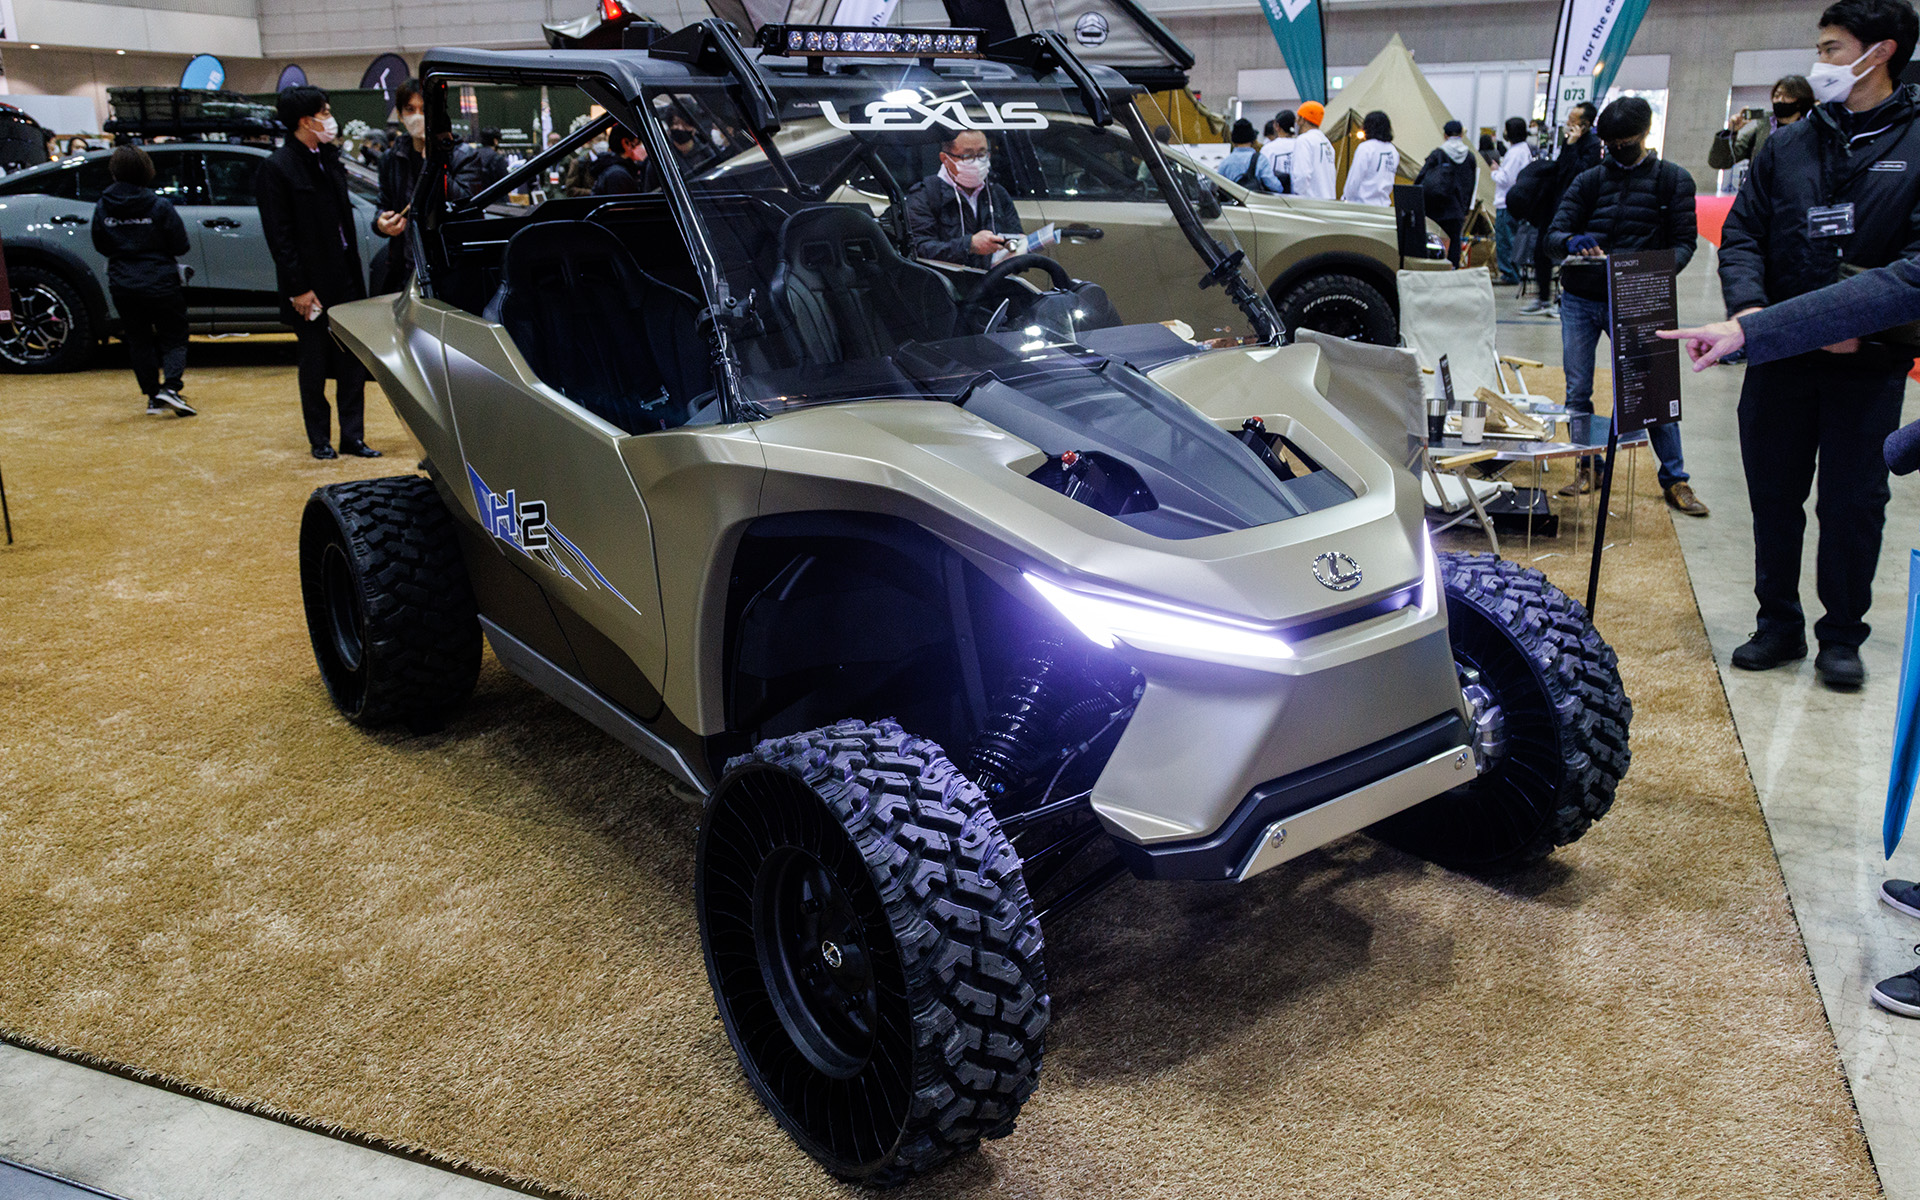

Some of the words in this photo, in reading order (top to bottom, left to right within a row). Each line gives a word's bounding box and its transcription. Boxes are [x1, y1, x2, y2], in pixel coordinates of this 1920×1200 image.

[1582, 41, 1595, 62] for
[1591, 16, 1608, 40] the
[1564, 89, 1585, 101] 073
[818, 100, 1050, 131] LEXUS
[489, 489, 549, 550] H2
